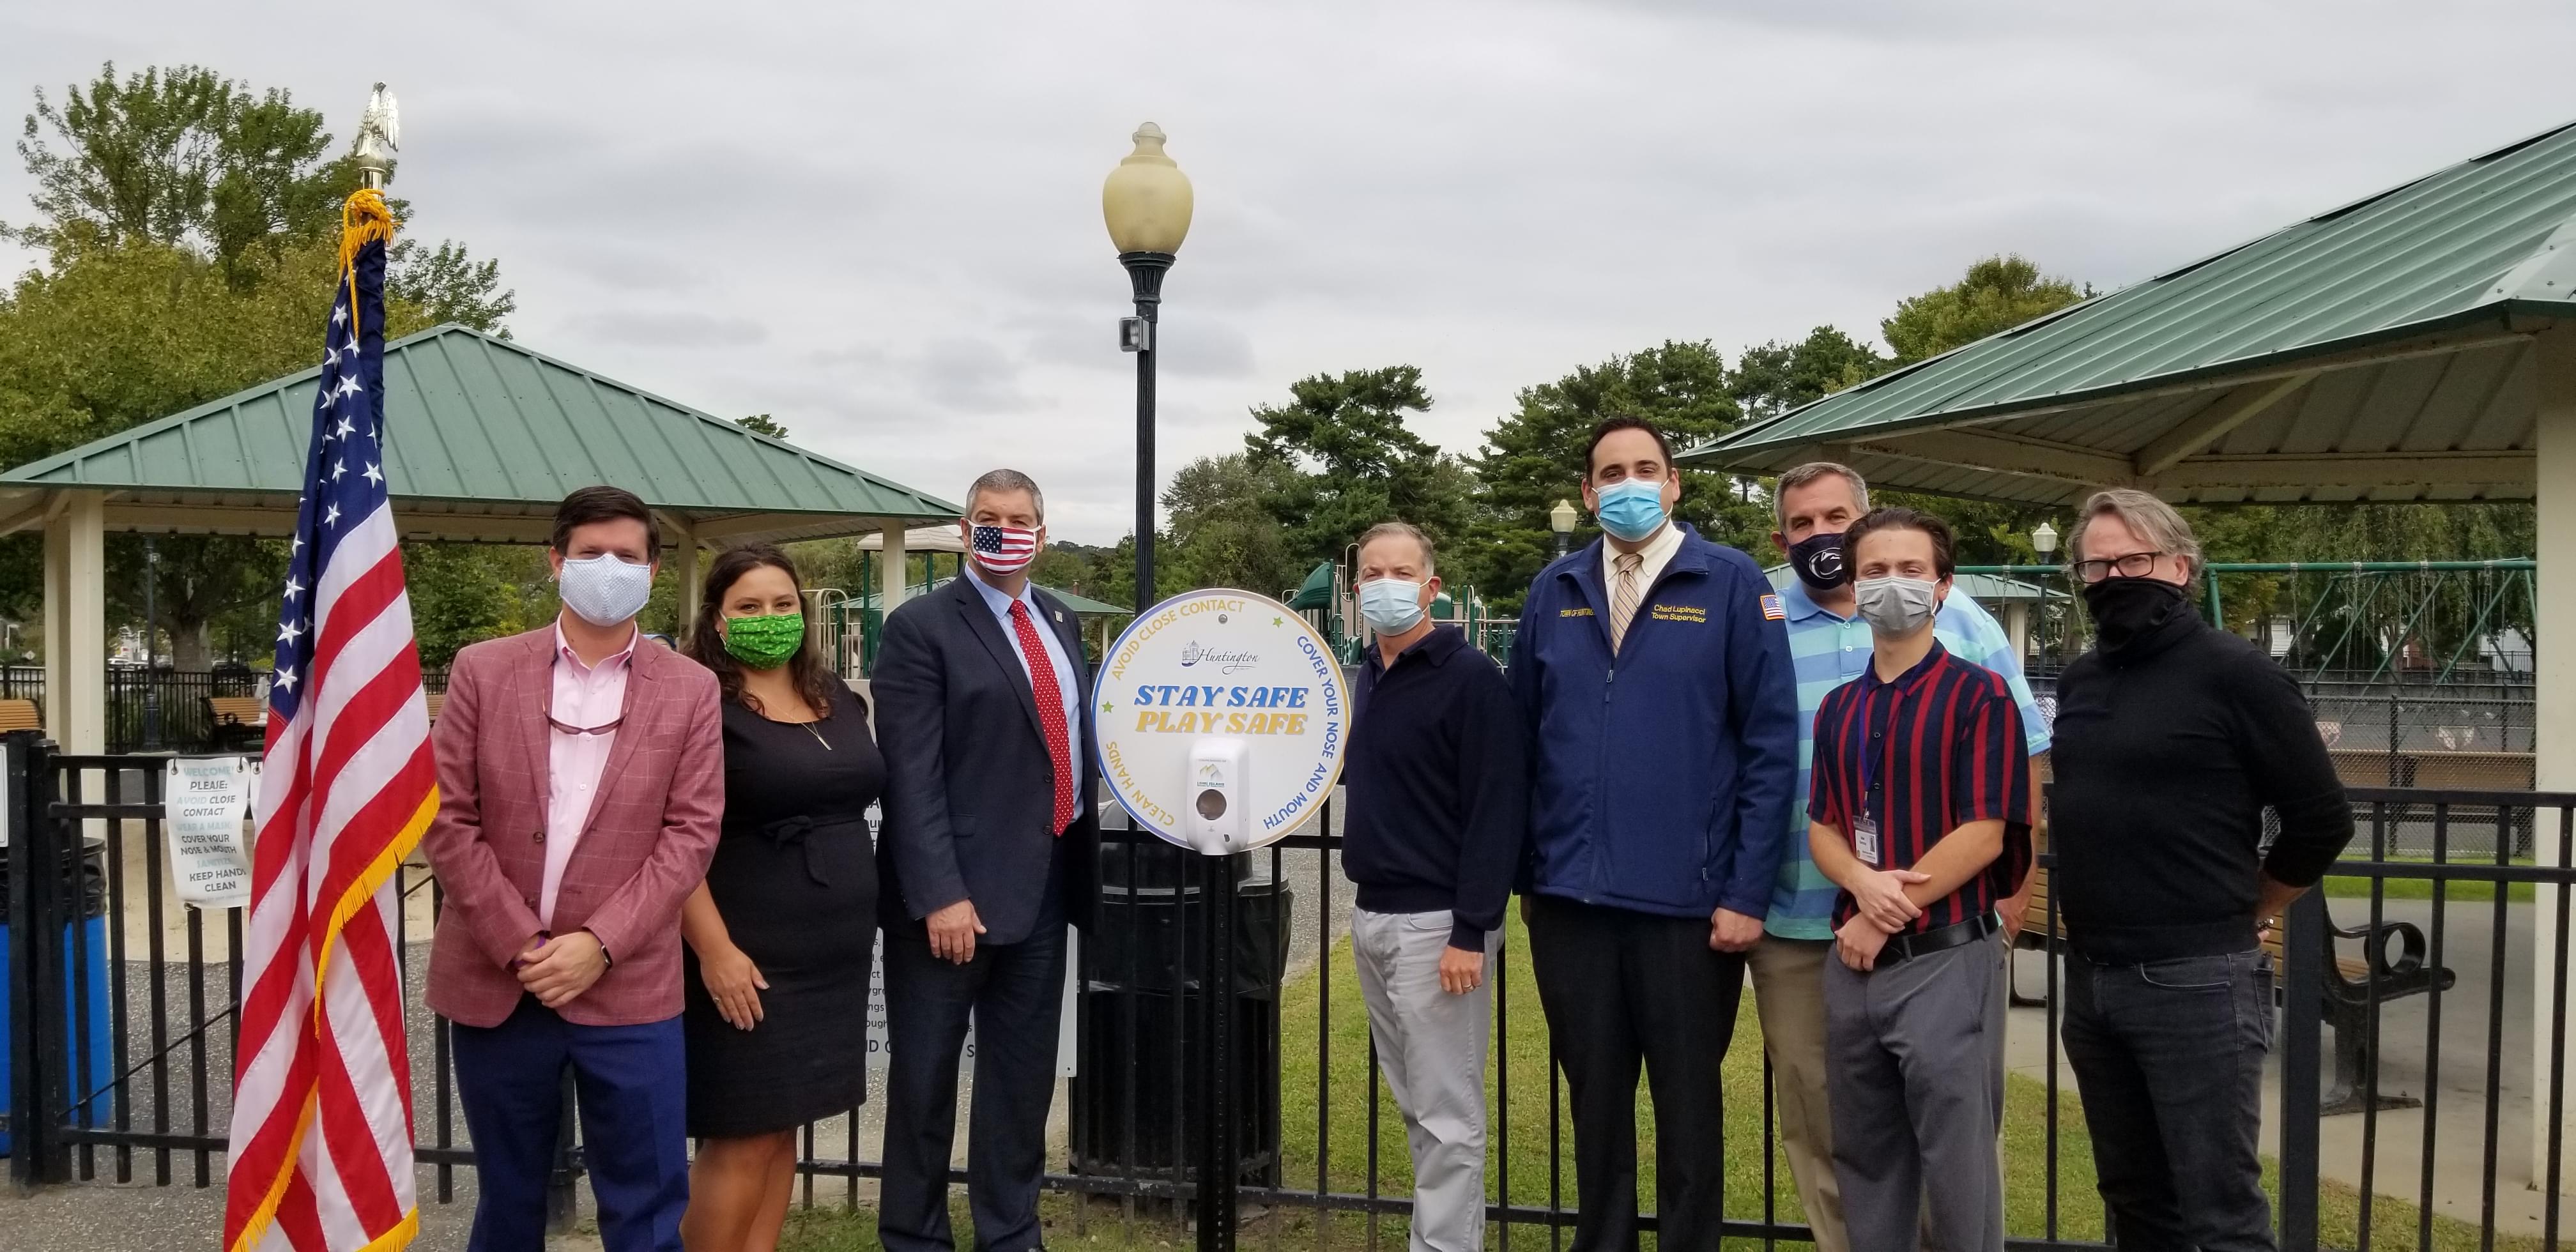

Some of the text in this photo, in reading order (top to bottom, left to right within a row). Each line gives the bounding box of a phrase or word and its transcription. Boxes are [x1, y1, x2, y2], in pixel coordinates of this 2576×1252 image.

[1673, 606, 1705, 615] Lupinacci
[1669, 614, 1706, 623] Supervisor
[1112, 599, 1245, 680] AVOID CLOSE CONTACT
[1199, 647, 1260, 675] Huntington
[1133, 685, 1309, 708] STAY SAFE
[1135, 711, 1308, 735] PLAY SAFE
[1263, 636, 1338, 830] COVER YOUR NOSE AND MOUTH
[190, 781, 227, 790] PLEASE:
[1106, 741, 1174, 826] CLEAN HANDS
[209, 795, 236, 804] CLOSE
[183, 807, 226, 816] CONTACT
[181, 834, 229, 843] COVER YOUR
[180, 846, 203, 855] NOSE
[210, 845, 237, 854] MOUTH
[189, 871, 213, 882] KEEP
[204, 881, 236, 892] CLEAN
